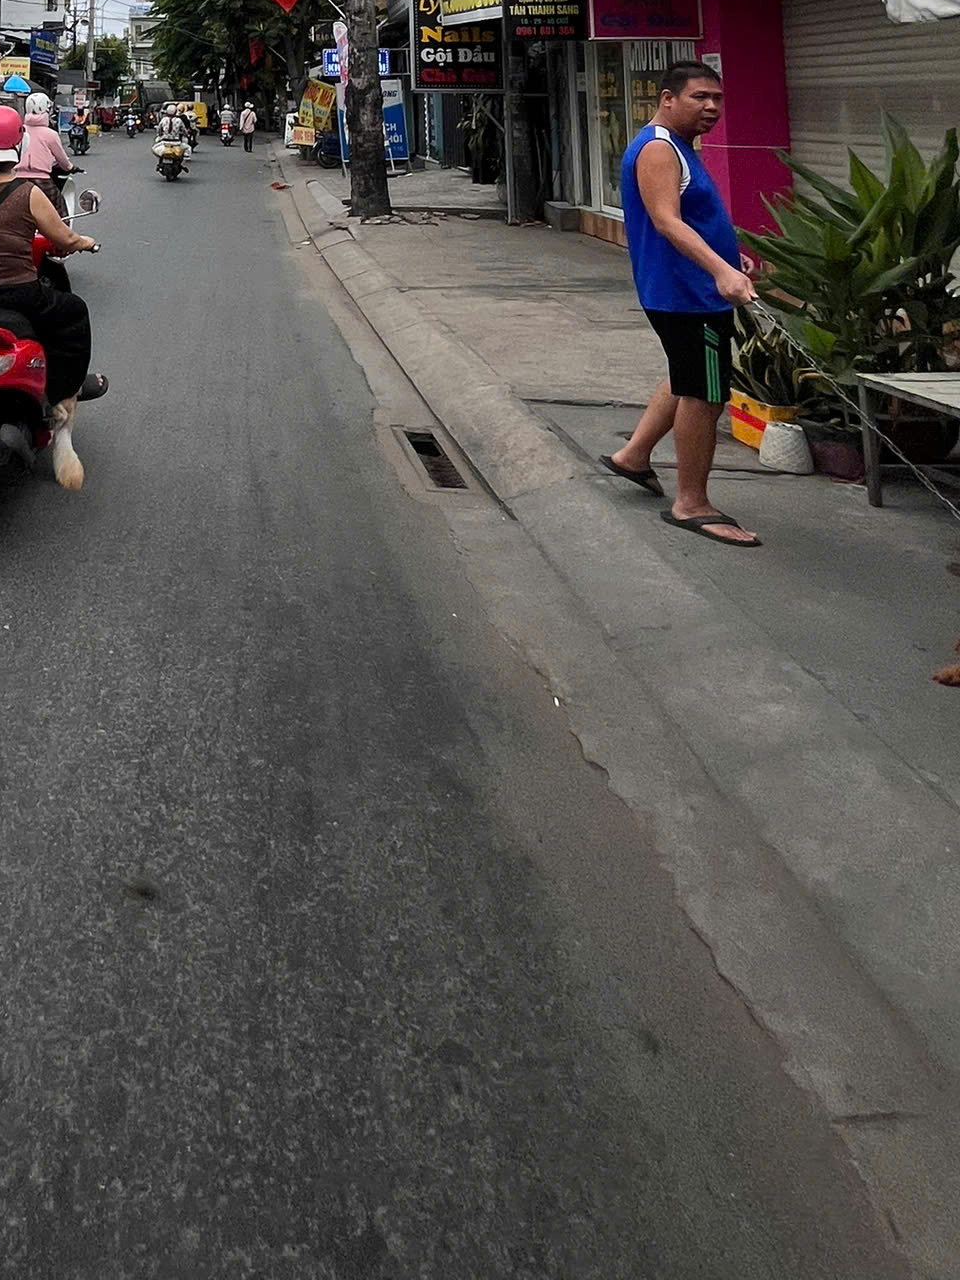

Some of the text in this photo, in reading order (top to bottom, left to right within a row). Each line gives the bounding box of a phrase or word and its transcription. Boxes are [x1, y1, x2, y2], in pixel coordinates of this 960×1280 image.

[420, 25, 495, 43] Nails
[420, 45, 496, 66] Gội Đầu
